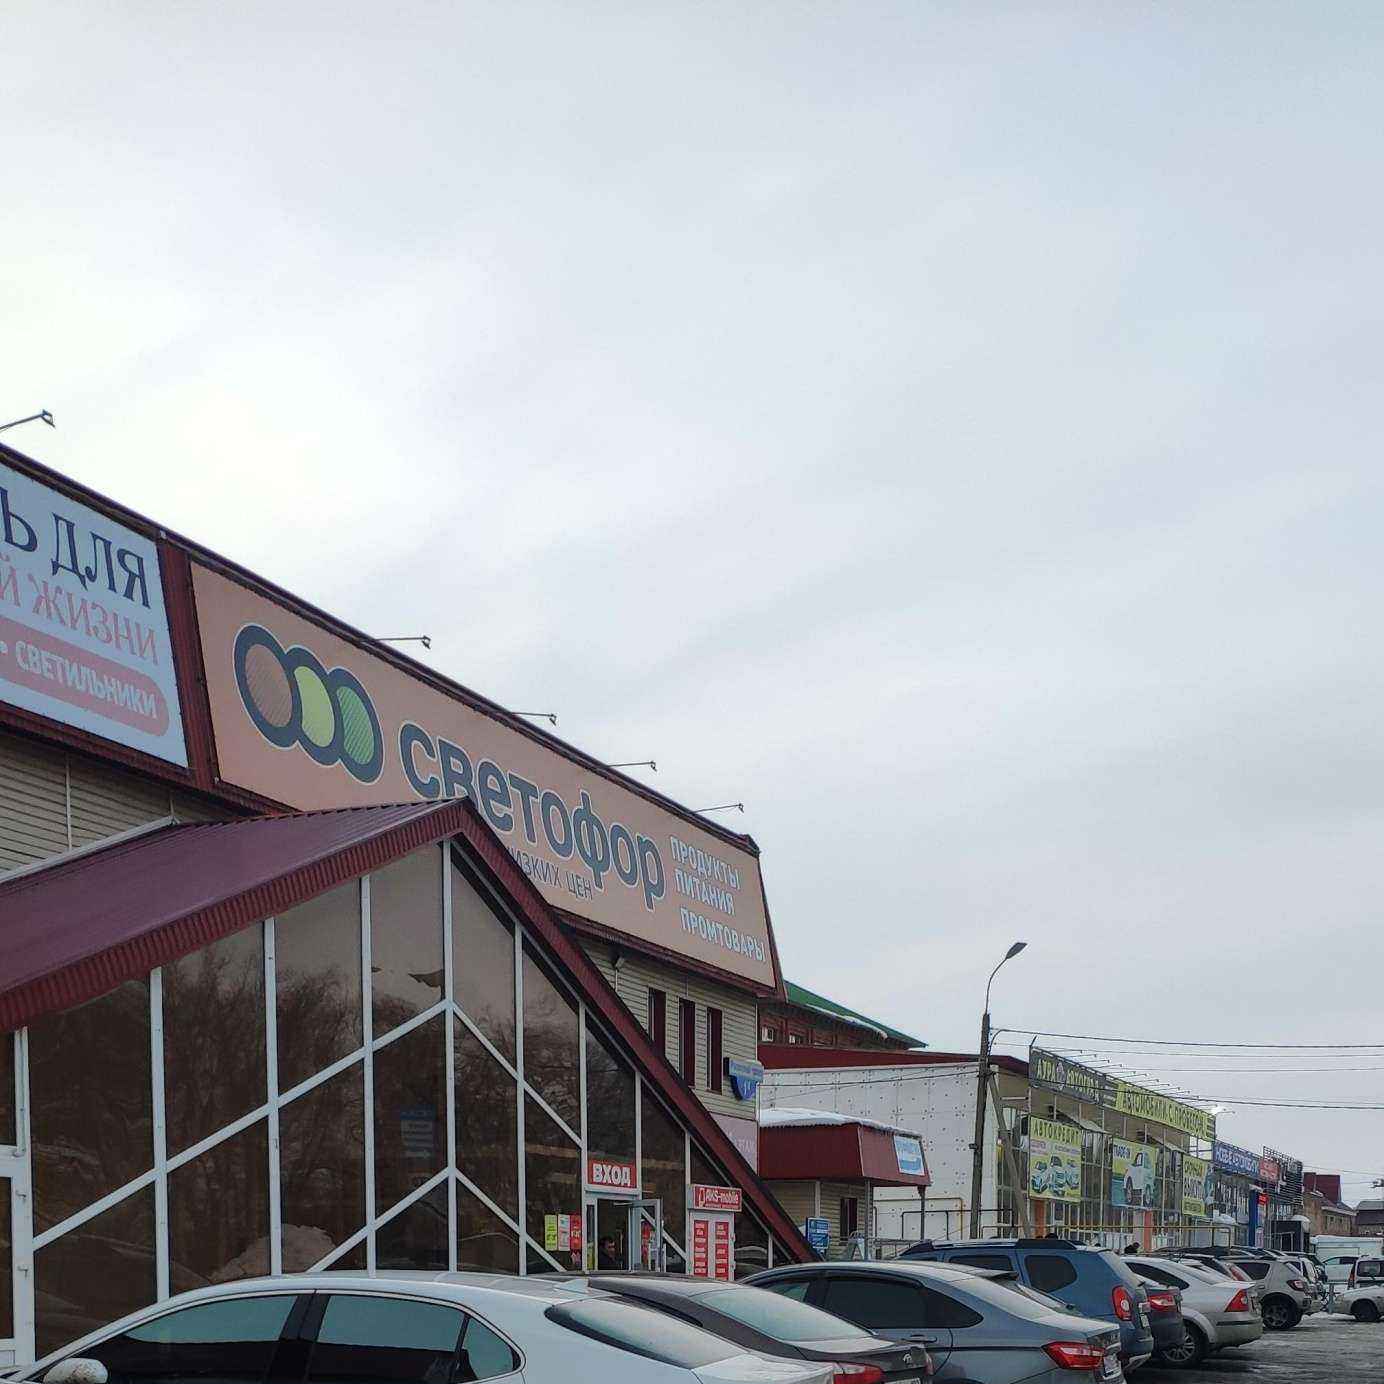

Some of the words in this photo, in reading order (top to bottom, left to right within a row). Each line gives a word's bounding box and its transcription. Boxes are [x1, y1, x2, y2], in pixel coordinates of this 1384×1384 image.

[51, 511, 151, 610] ДЛЯ
[28, 573, 158, 666] ЖИЗНИ
[15, 639, 158, 719] СВЕТИЛЬНИКИ
[565, 871, 593, 901] ЦЕН
[670, 836, 742, 890] ПРОДУКТЫ
[674, 868, 736, 916] ПИТАНИЯ
[680, 907, 766, 962] ПРОМТОВАРЫ
[592, 1163, 631, 1187] ВХОД
